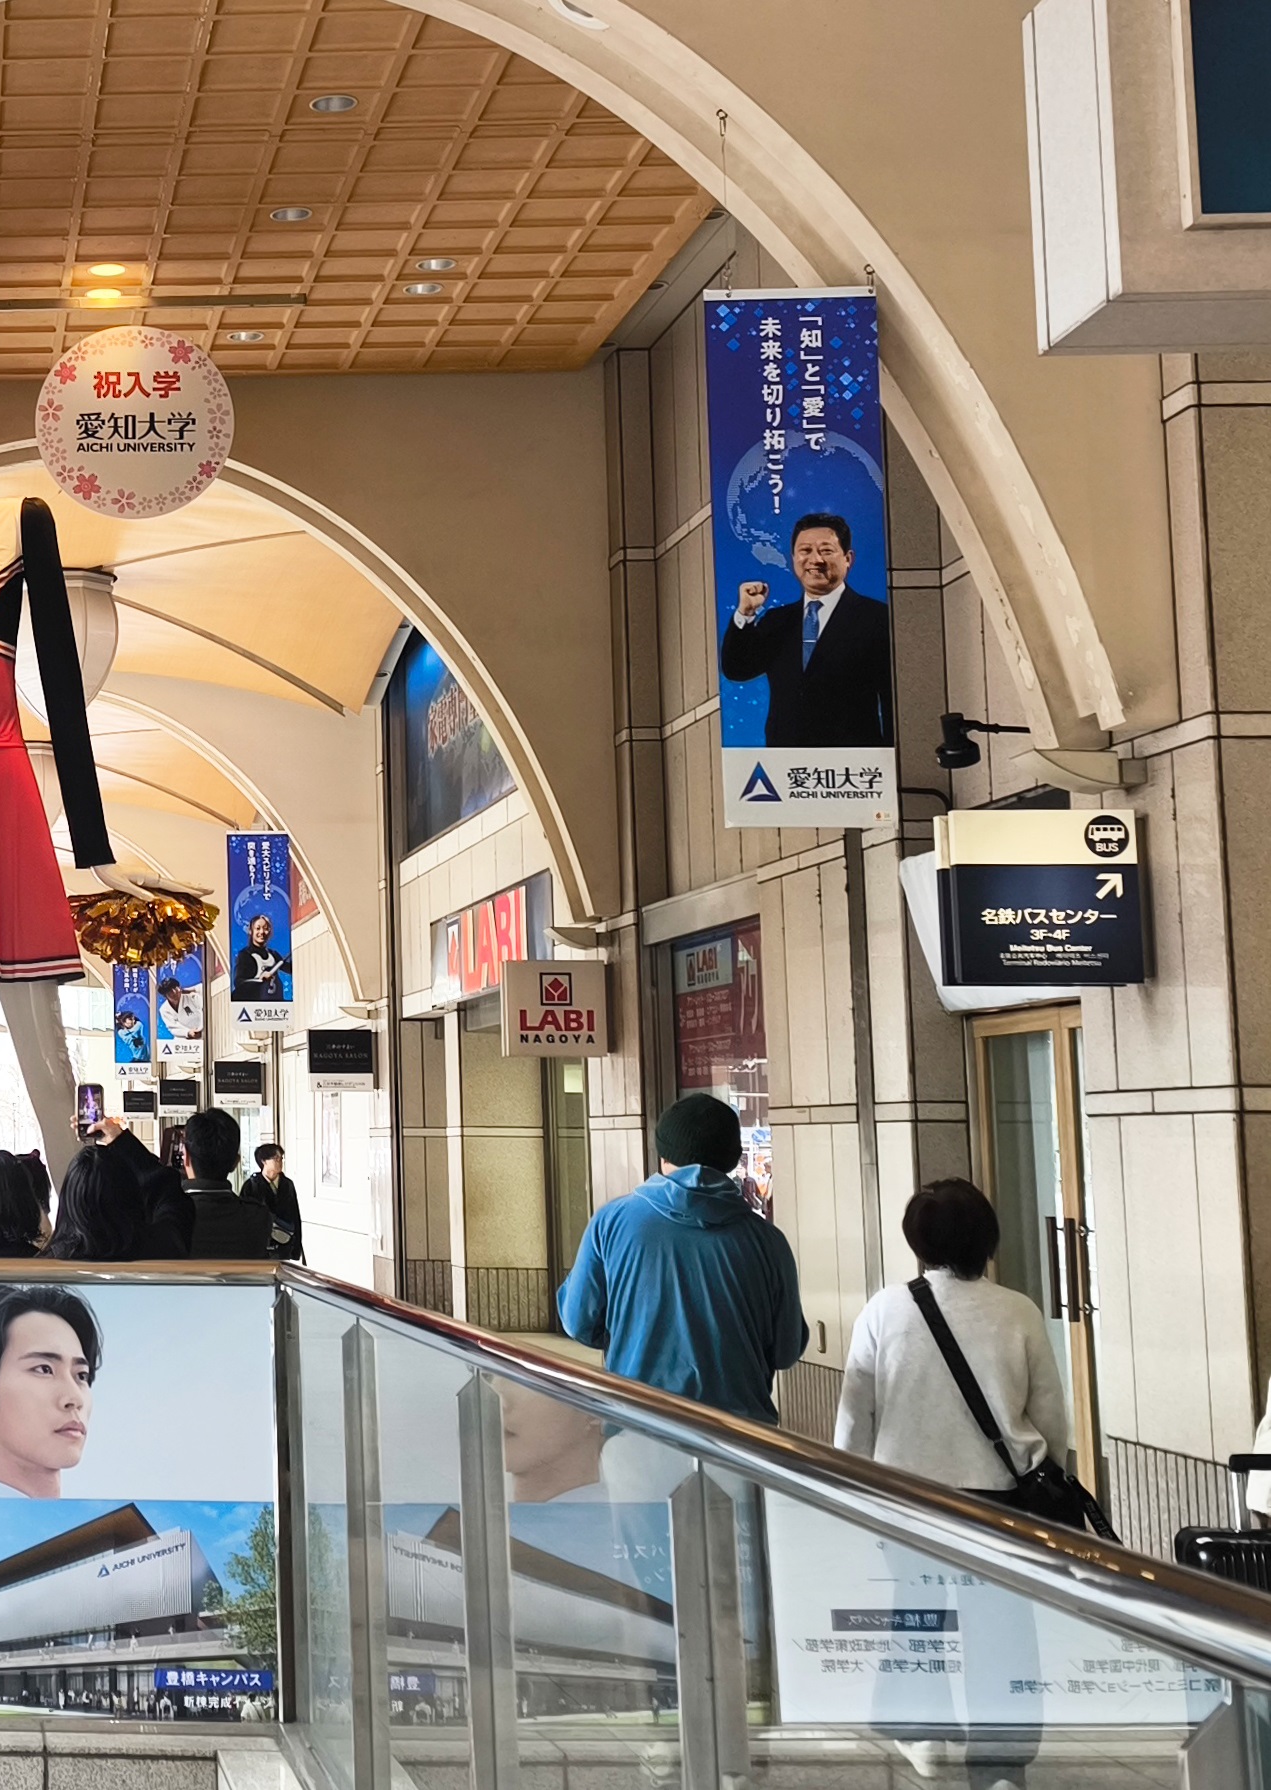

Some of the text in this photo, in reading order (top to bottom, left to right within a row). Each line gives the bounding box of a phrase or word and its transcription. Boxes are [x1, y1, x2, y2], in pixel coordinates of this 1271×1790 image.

[93, 371, 181, 398] 祝入学
[798, 316, 826, 450] 「知」と「愛」で
[75, 411, 196, 441] 愛知大学
[759, 317, 785, 514] 未来を切り拓こう！
[76, 442, 196, 453] AICHI UNIVERSITY
[787, 767, 883, 789] 愛知大学
[789, 791, 883, 799] AICHI UNIVERSITY
[1095, 843, 1119, 852] BUS
[980, 908, 1117, 925] 名鉄バスセンター
[461, 886, 528, 993] LABI
[696, 947, 718, 973] LABI
[520, 1009, 595, 1032] LABI
[520, 1034, 595, 1044] NAGOYA
[112, 1542, 187, 1572] AICHI UNIVERSITY
[165, 1671, 262, 1687] 豊橋キャンパス
